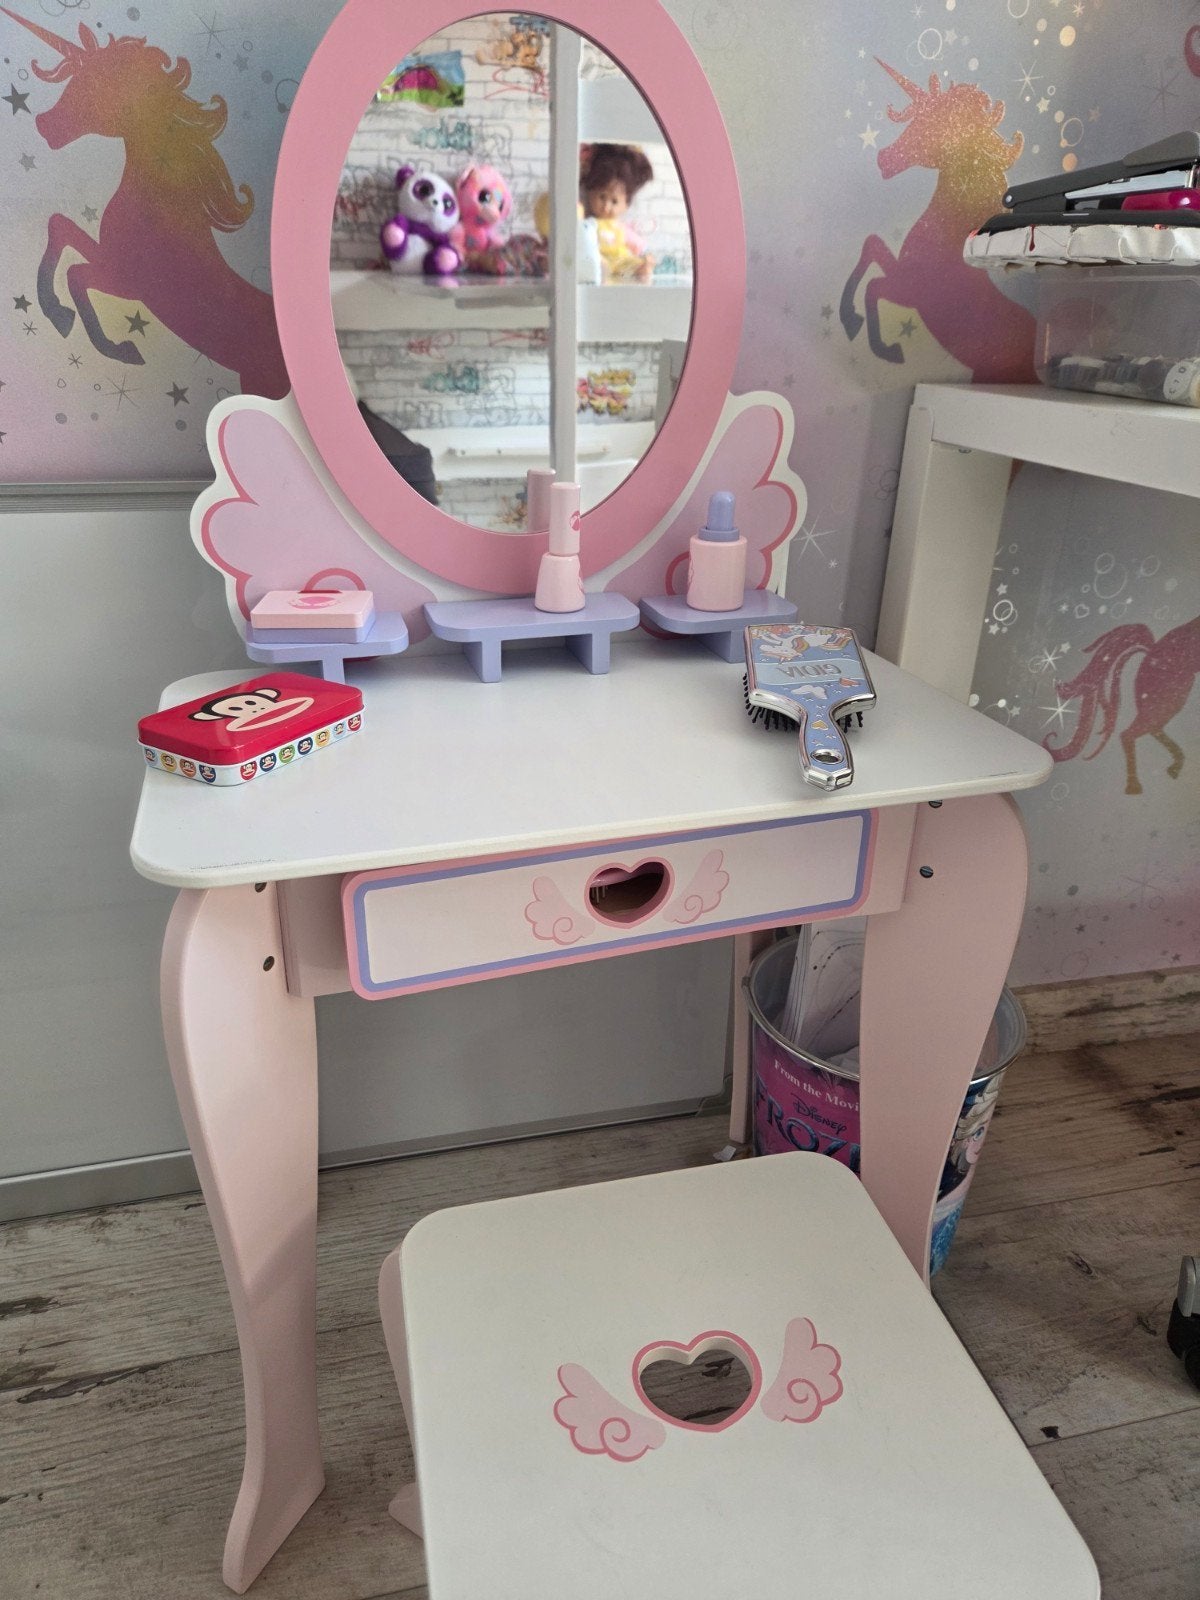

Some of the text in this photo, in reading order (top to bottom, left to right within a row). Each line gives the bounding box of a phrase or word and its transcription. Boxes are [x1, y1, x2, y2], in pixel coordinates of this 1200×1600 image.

[756, 1071, 861, 1174] FROZ
[774, 1059, 860, 1112] From the Movi
